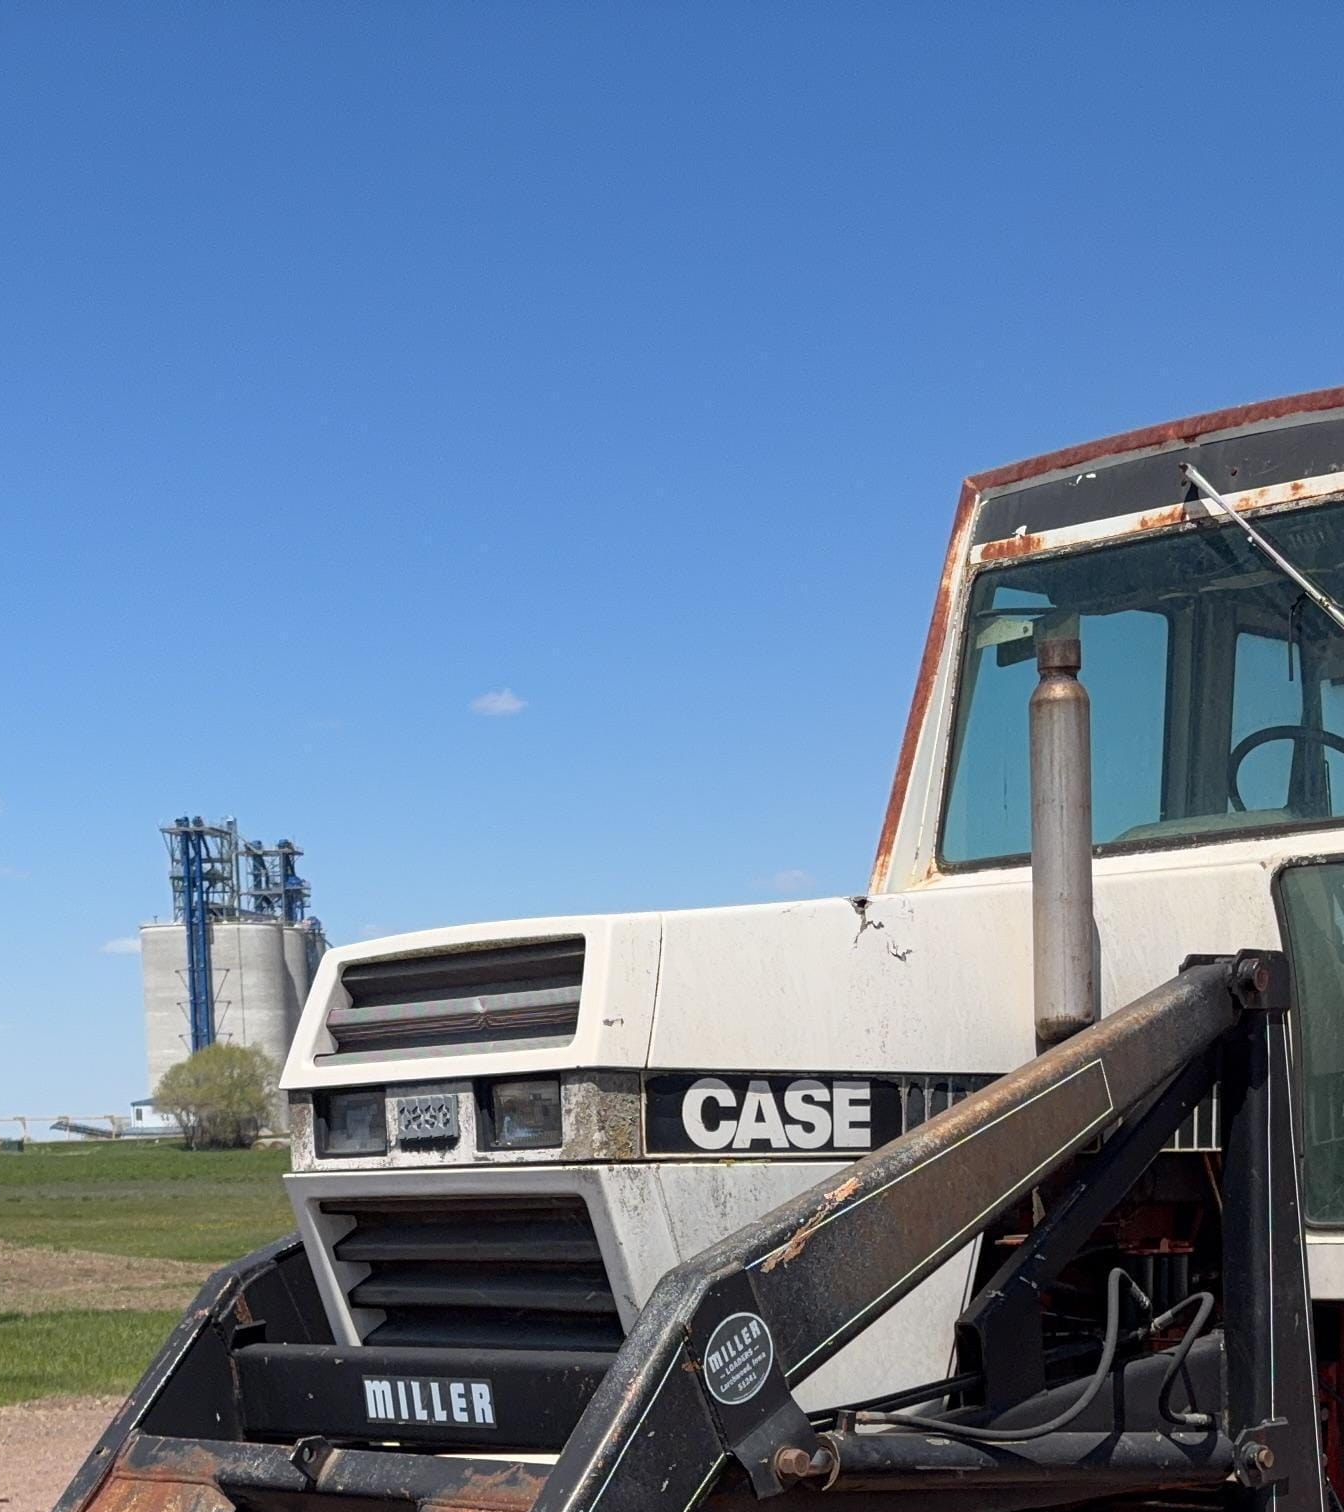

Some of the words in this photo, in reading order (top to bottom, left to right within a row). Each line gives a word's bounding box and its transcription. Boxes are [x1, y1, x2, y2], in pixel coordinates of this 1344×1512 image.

[682, 1078, 872, 1150] CASE
[708, 1320, 761, 1373] MILLER
[725, 1347, 753, 1376] LOADERS
[363, 1380, 495, 1424] MILLER
